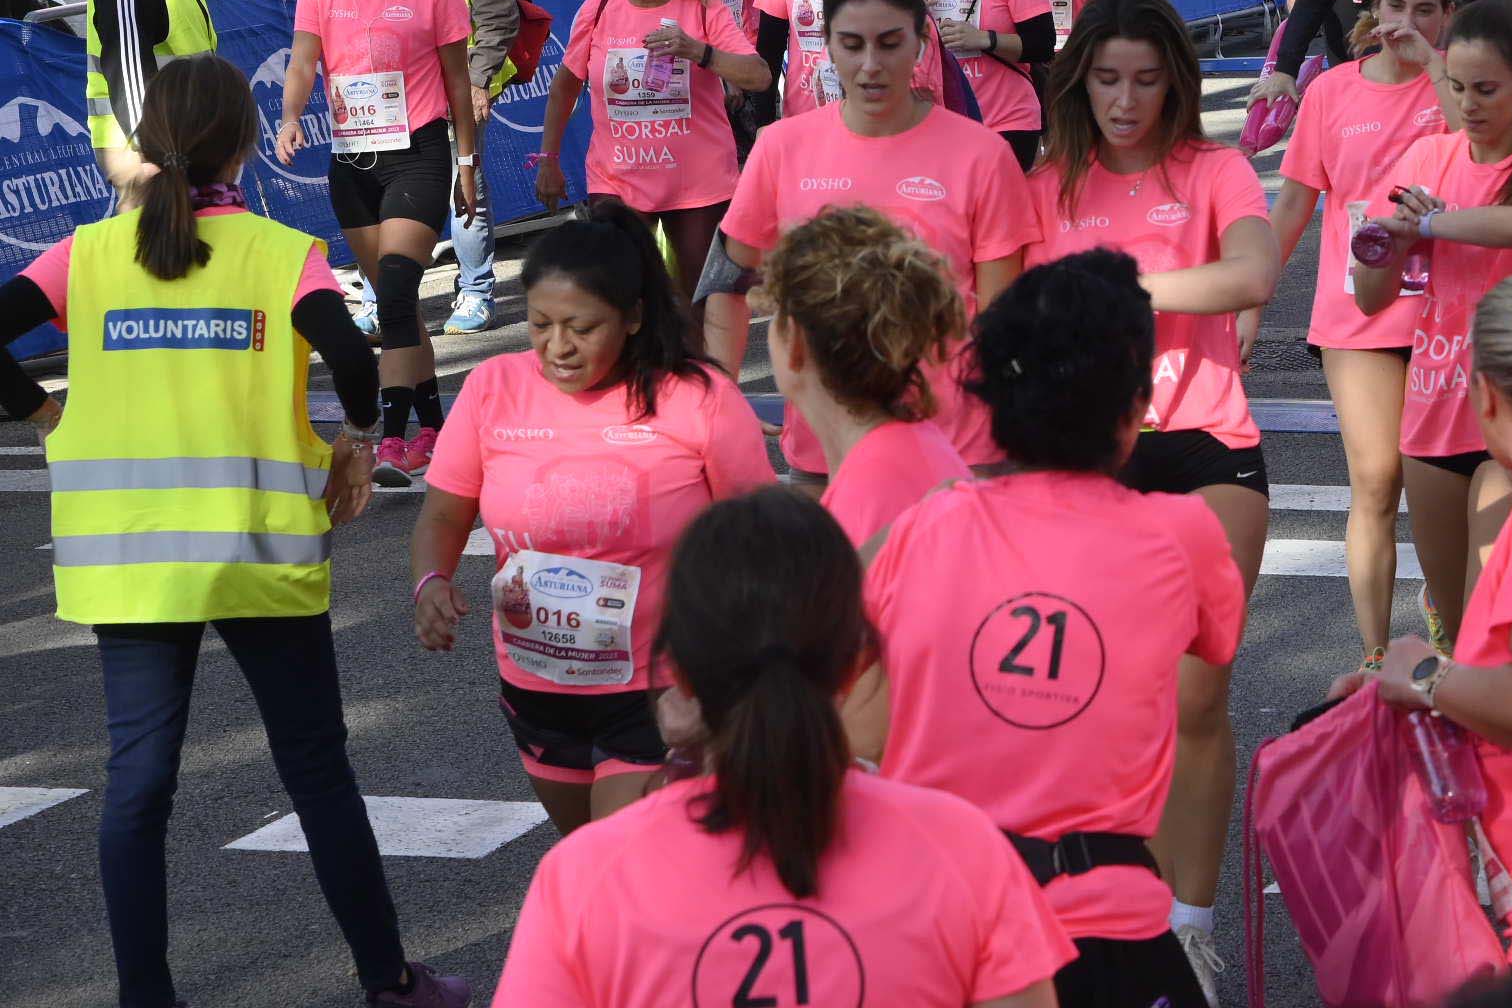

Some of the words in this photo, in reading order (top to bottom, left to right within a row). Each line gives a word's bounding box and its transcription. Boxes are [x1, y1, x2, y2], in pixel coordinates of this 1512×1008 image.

[349, 104, 377, 118] 016
[609, 120, 692, 140] DORSAL
[1341, 120, 1382, 138] OYSHO
[612, 145, 677, 165] SUMA
[800, 176, 852, 192] OYSHO
[107, 319, 248, 340] VOLUNTARIS
[493, 428, 554, 441] OYSHO
[533, 575, 588, 594] ASTURIANA
[536, 606, 581, 629] 016
[541, 630, 577, 645] 12658
[998, 606, 1068, 680] 21
[567, 649, 596, 660] MUJER
[730, 919, 811, 1008] 21
